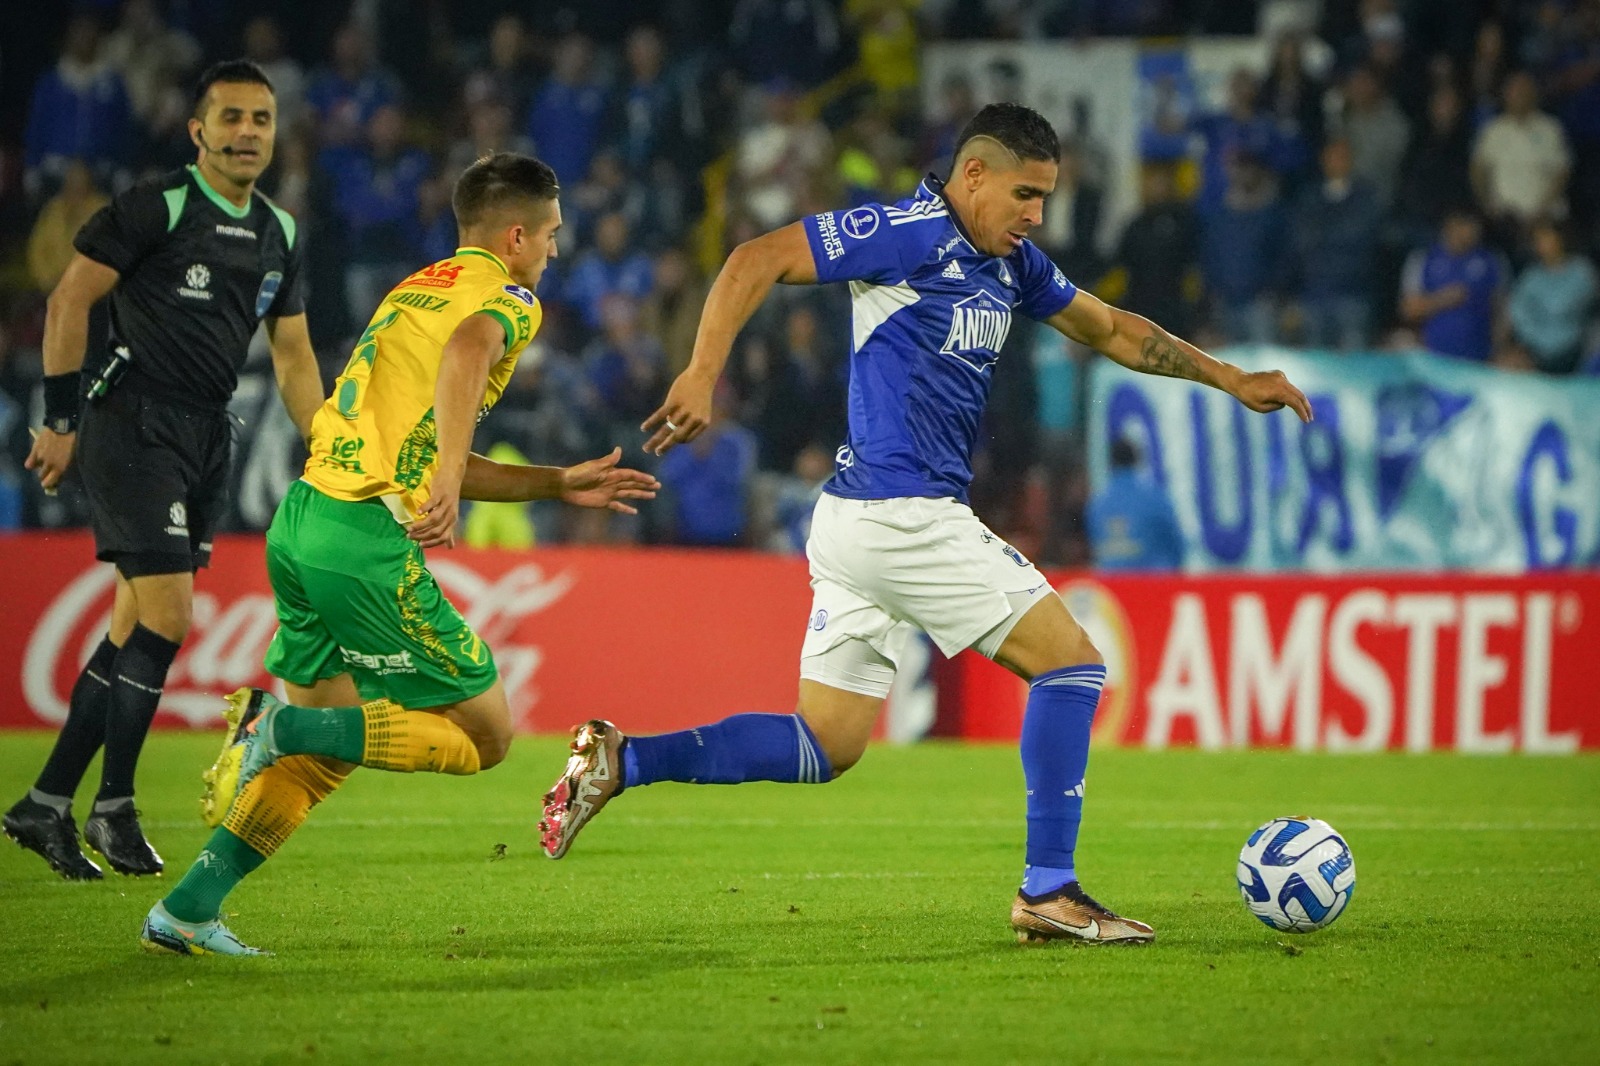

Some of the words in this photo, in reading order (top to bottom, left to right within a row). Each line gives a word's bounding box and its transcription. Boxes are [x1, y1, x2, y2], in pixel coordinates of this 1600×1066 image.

[216, 224, 257, 240] marathon
[941, 271, 966, 280] adidas
[1145, 587, 1582, 755] AMSTEL
